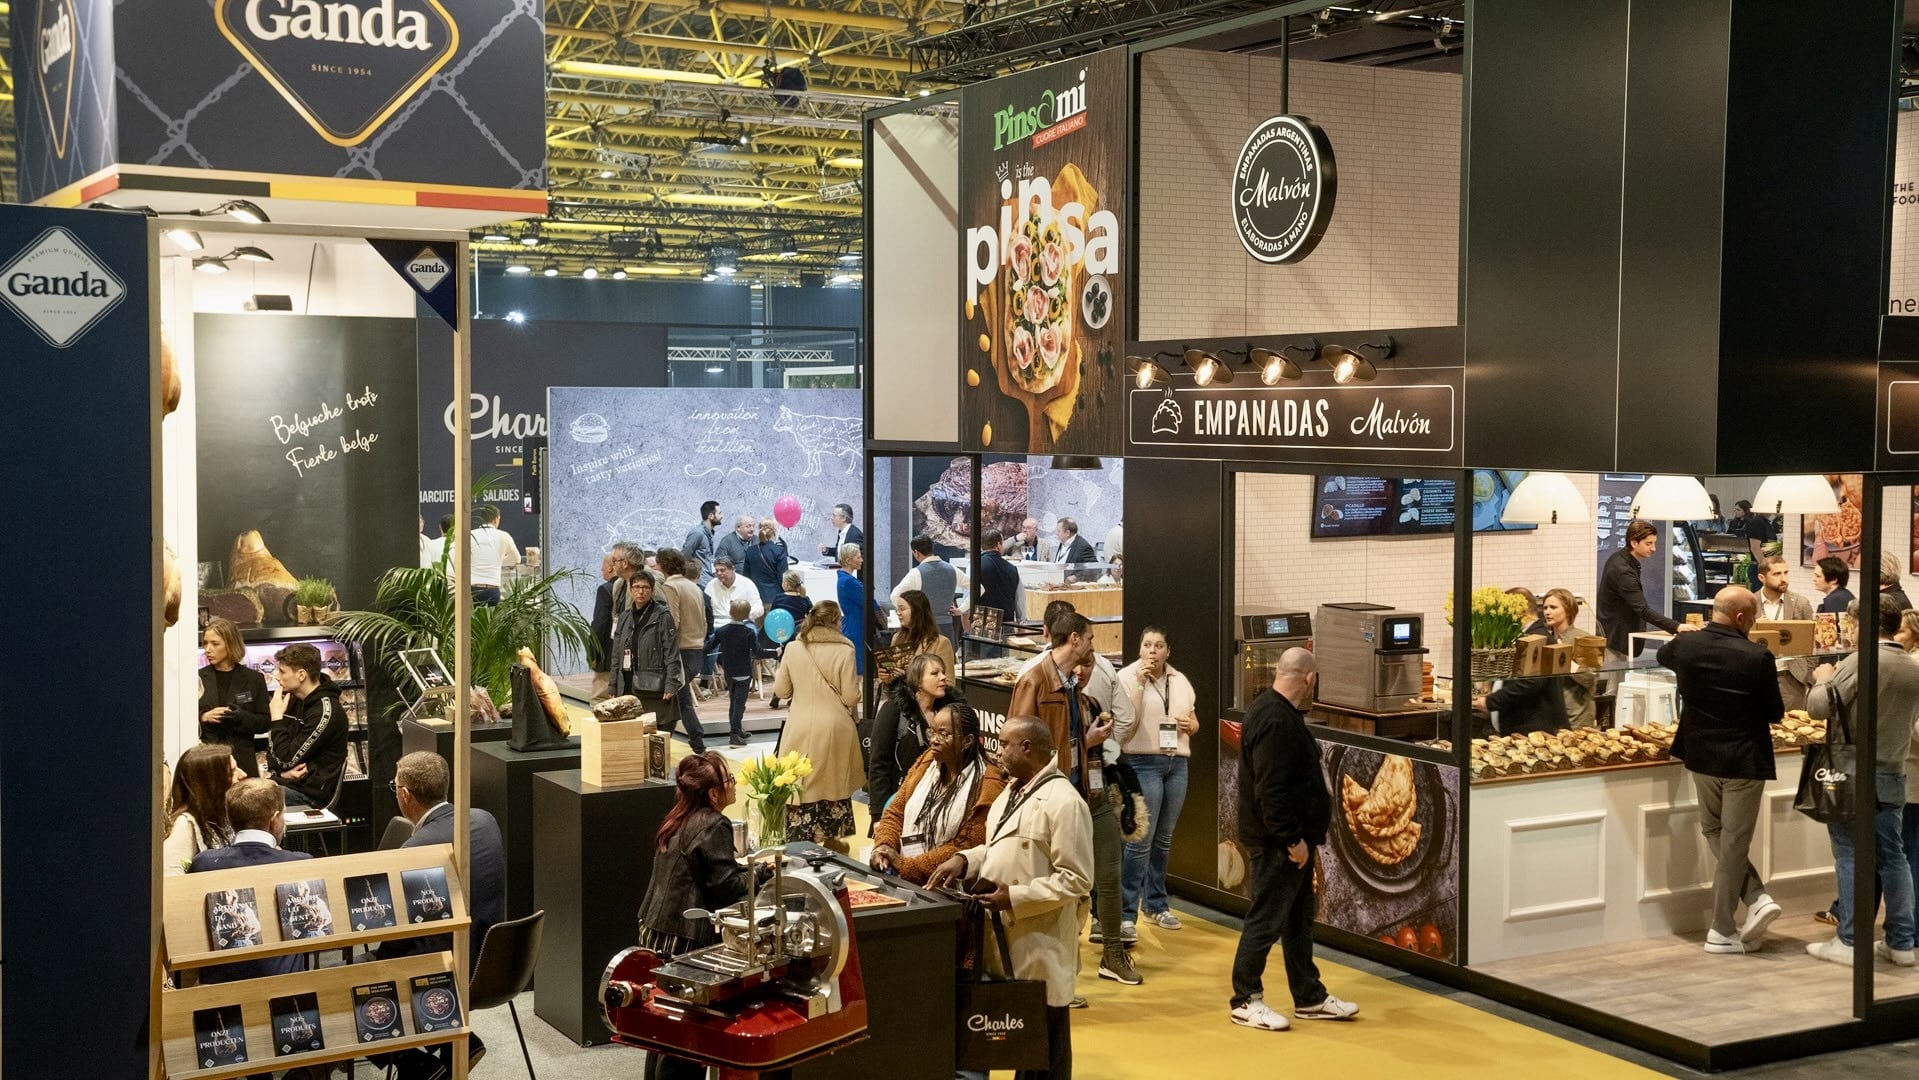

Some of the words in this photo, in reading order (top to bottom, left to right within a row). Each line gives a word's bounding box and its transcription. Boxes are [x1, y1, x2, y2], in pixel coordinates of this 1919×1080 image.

[245, 0, 433, 50] Ganda
[311, 64, 343, 74] SINCE
[348, 66, 372, 76] 1954
[1036, 128, 1056, 144] CUORE
[1057, 116, 1084, 137] ITALIANO
[1240, 128, 1276, 179] EMPANADAS
[1276, 127, 1313, 172] ARGENTINAS
[1015, 162, 1023, 178] is
[1022, 162, 1035, 178] the
[1239, 167, 1311, 208] Malvón
[1893, 182, 1914, 193] THE
[1892, 195, 1919, 205] FOO
[1240, 217, 1283, 252] ELABORADAS
[1283, 238, 1290, 248] A
[1289, 211, 1308, 242] MANO
[966, 176, 1119, 306] pinsa
[410, 262, 445, 273] Ganda
[7, 271, 110, 298] Ganda
[1890, 298, 1919, 314] ne
[269, 402, 343, 445] Belgische
[346, 385, 378, 411] trots
[688, 401, 760, 420] innovation
[1194, 398, 1329, 438] EMPANADAS
[1350, 397, 1431, 440] Malvón
[340, 429, 379, 454] belge
[495, 445, 523, 453] SINCE
[695, 435, 755, 453] tradition
[570, 457, 609, 476] Inspire
[610, 444, 636, 462] with
[585, 468, 613, 485] tasty
[482, 488, 520, 502] SALADES
[972, 708, 1006, 734] INS
[984, 736, 1000, 751] MO
[360, 895, 379, 904] ONZE
[420, 888, 435, 896] NOS
[351, 903, 392, 914] PRODUCTEN
[412, 895, 446, 906] PRODUITS
[289, 1015, 305, 1023] NOS
[967, 1012, 1024, 1032] Charles
[210, 1029, 231, 1038] ONZE
[280, 1023, 317, 1034] PRODUITS
[199, 1036, 244, 1049] PRODUCTEN
